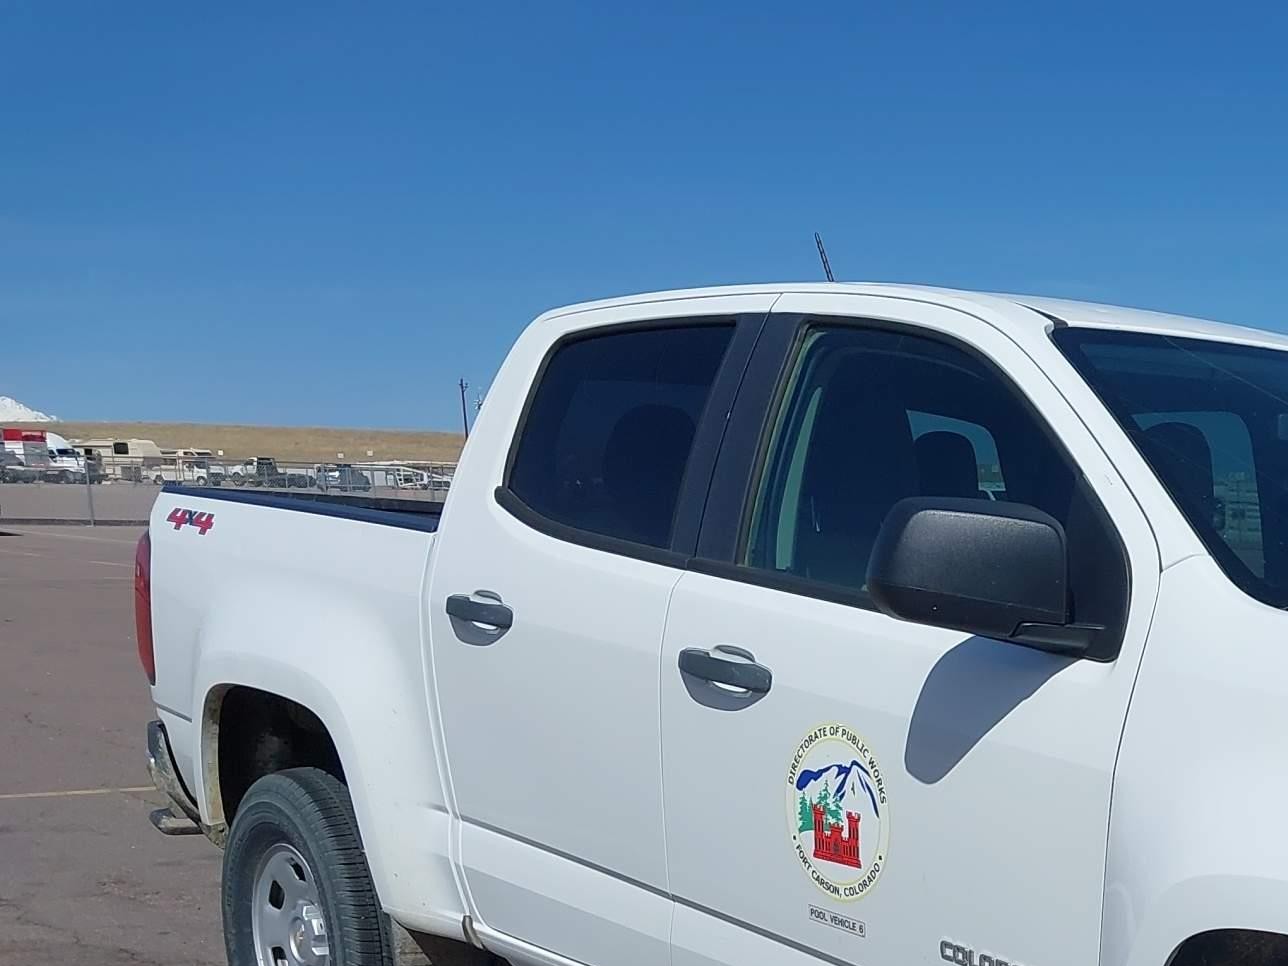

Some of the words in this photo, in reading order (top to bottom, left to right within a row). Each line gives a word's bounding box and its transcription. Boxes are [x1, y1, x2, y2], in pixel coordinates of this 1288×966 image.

[788, 727, 827, 785] DIRECTORATE
[829, 726, 840, 736] OF
[841, 728, 869, 758] PUBLIC
[868, 756, 887, 804] WORKS
[796, 844, 812, 870] FORT
[843, 863, 880, 897] COLORADO
[810, 908, 828, 922] POOL
[829, 914, 857, 931] VEHICLE
[858, 924, 865, 934] 6
